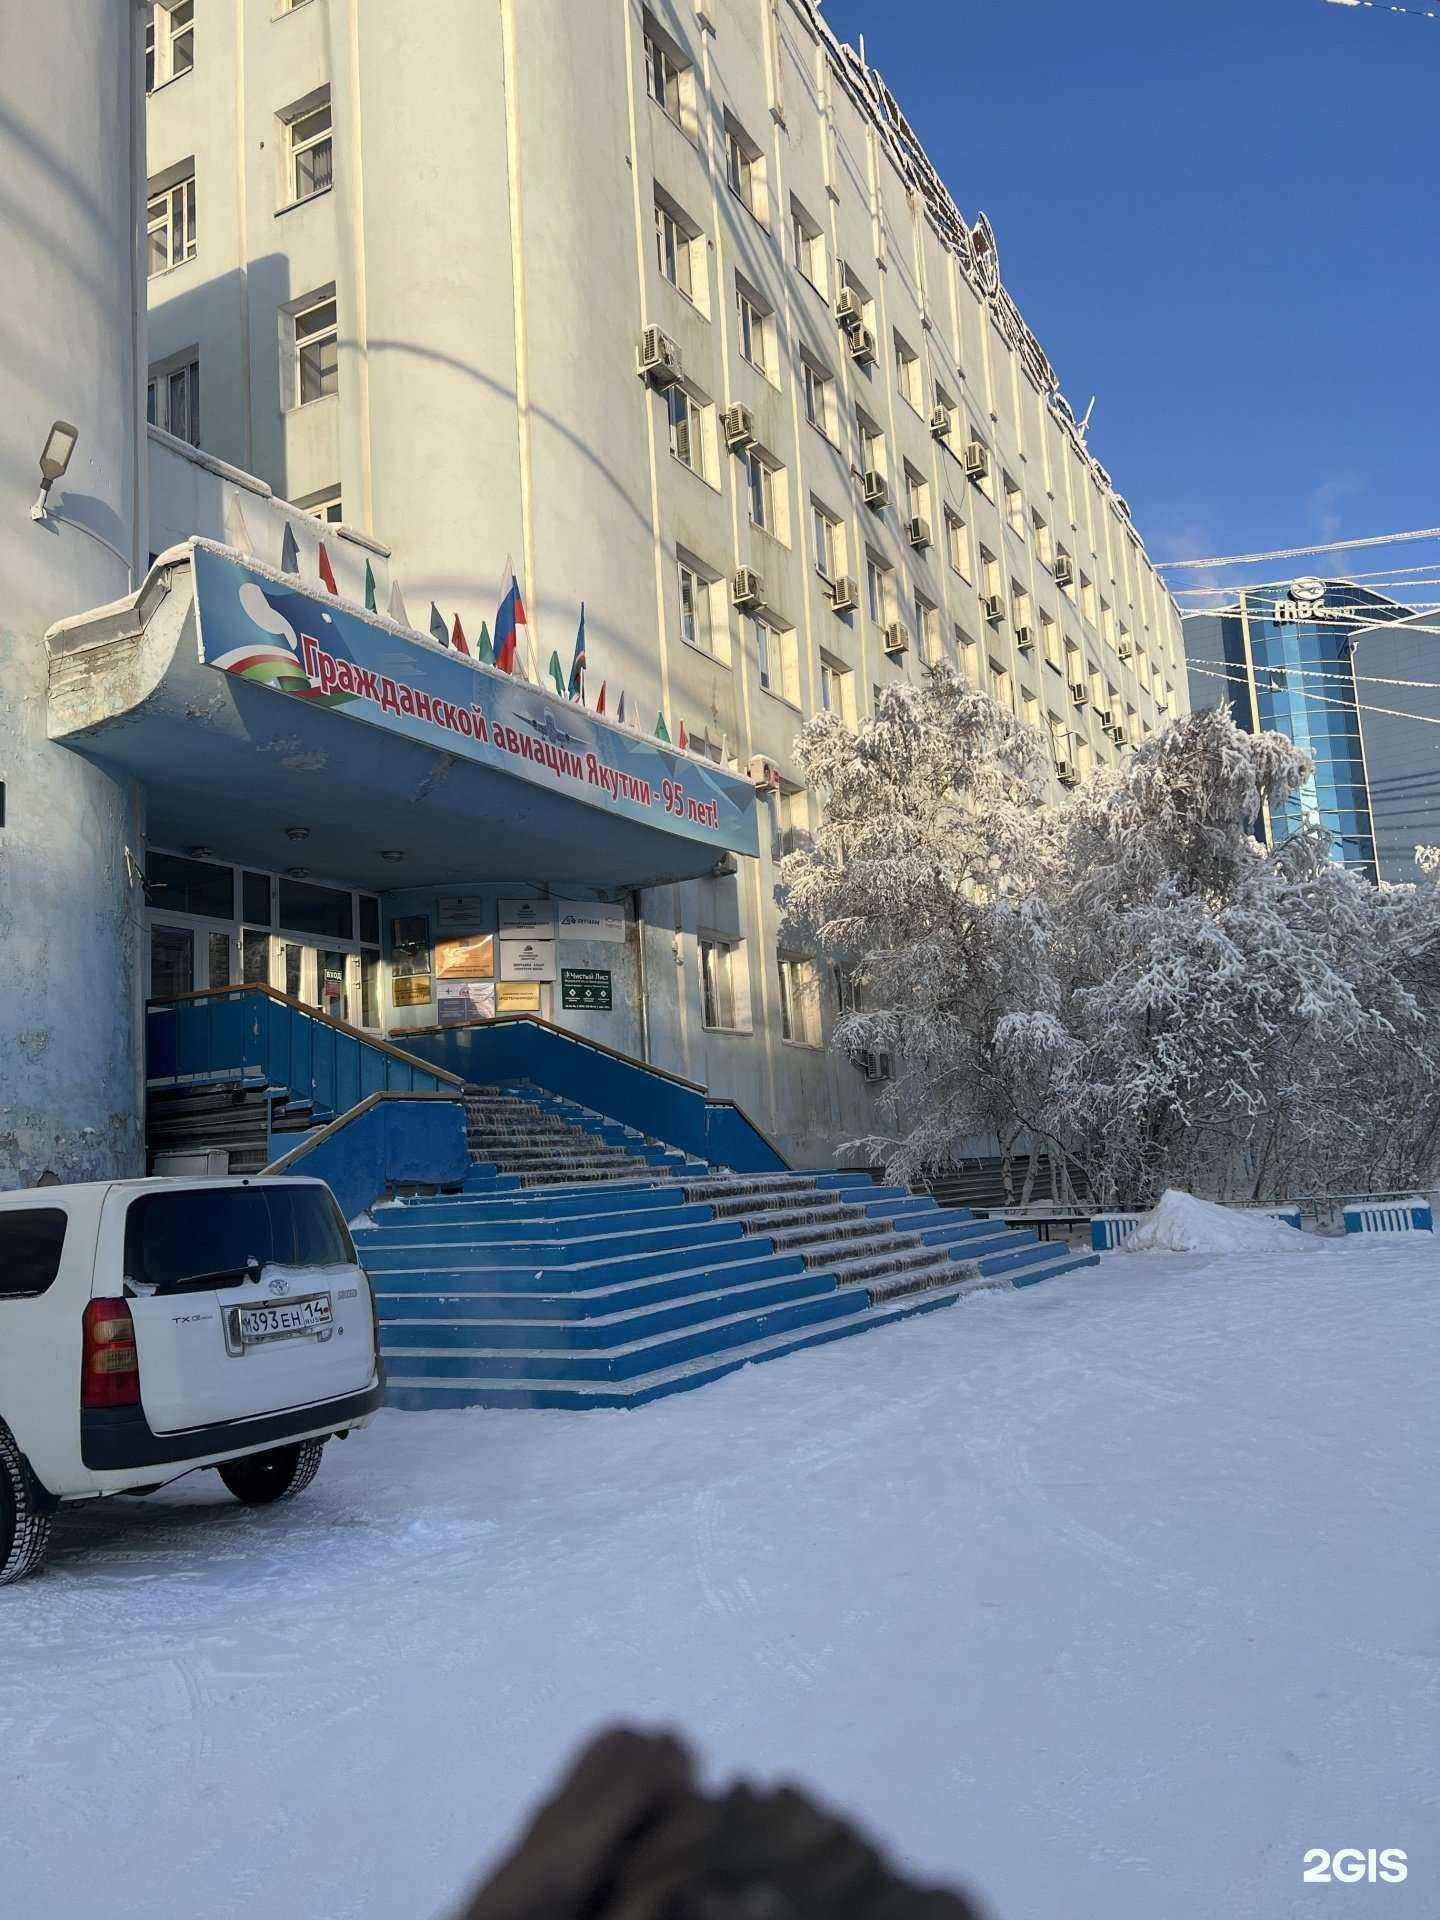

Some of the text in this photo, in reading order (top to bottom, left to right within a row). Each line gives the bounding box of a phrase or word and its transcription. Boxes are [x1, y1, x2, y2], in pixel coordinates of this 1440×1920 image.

[301, 633, 489, 743] Гражданской
[492, 719, 584, 781] авиации
[584, 752, 651, 806] Якутии
[662, 778, 684, 818] 95
[688, 798, 720, 831] лет!
[304, 1301, 324, 1317] 14
